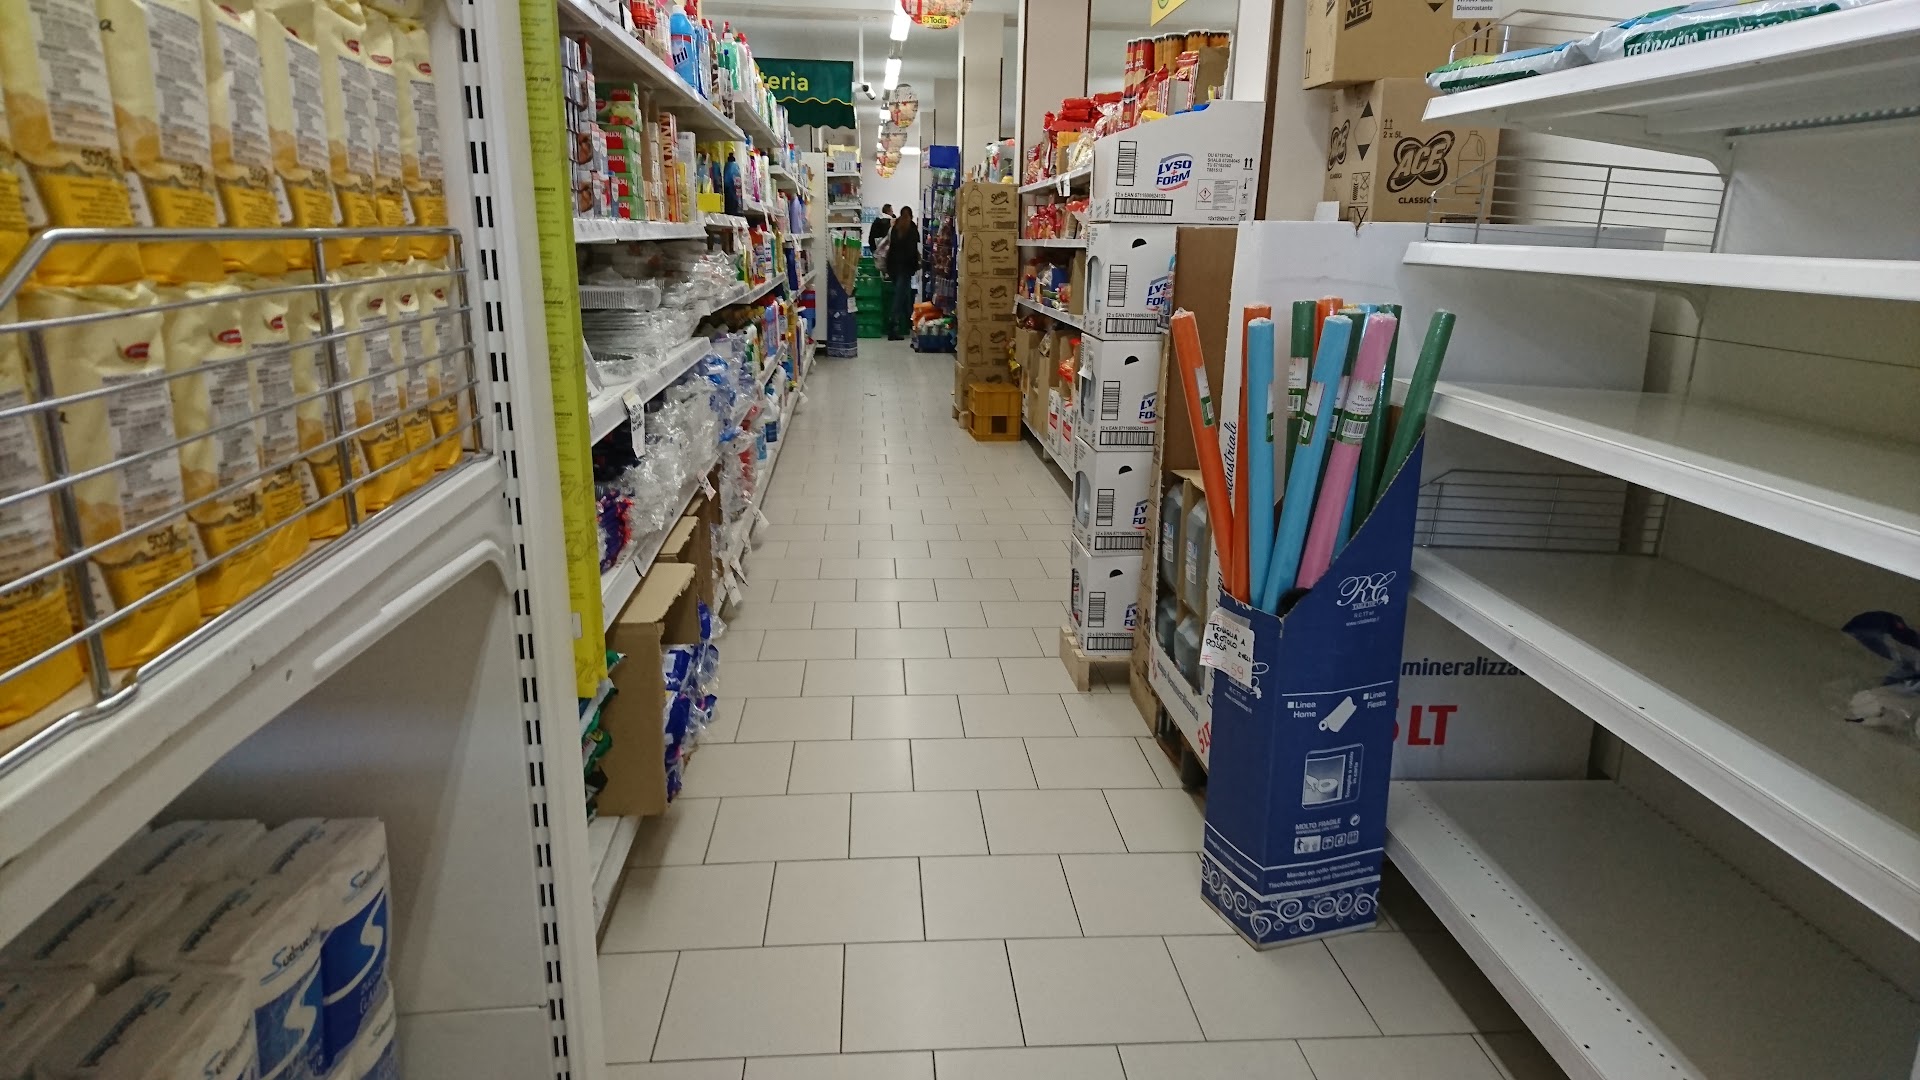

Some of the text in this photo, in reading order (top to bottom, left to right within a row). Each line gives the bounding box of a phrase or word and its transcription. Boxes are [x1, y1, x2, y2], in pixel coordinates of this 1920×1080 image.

[1347, 1, 1371, 21] NET
[929, 16, 948, 25] Todis
[672, 47, 688, 66] tril
[760, 71, 809, 91] teria
[1383, 131, 1388, 139] 2
[1394, 131, 1403, 139] 5L
[1396, 143, 1448, 177] ACE
[1158, 160, 1192, 175] LYSO
[1156, 170, 1191, 185] FORM
[1141, 398, 1155, 411] LY
[1139, 411, 1154, 420] FO
[1134, 505, 1148, 516] LY
[1133, 517, 1146, 525] FO
[1402, 656, 1526, 676] mineralizza
[1369, 691, 1387, 700] Linea
[1295, 701, 1317, 709] Linea
[1367, 700, 1387, 709] Fiesta
[1407, 704, 1458, 746] LT
[1295, 818, 1341, 830] MOLTO FRAGILE
